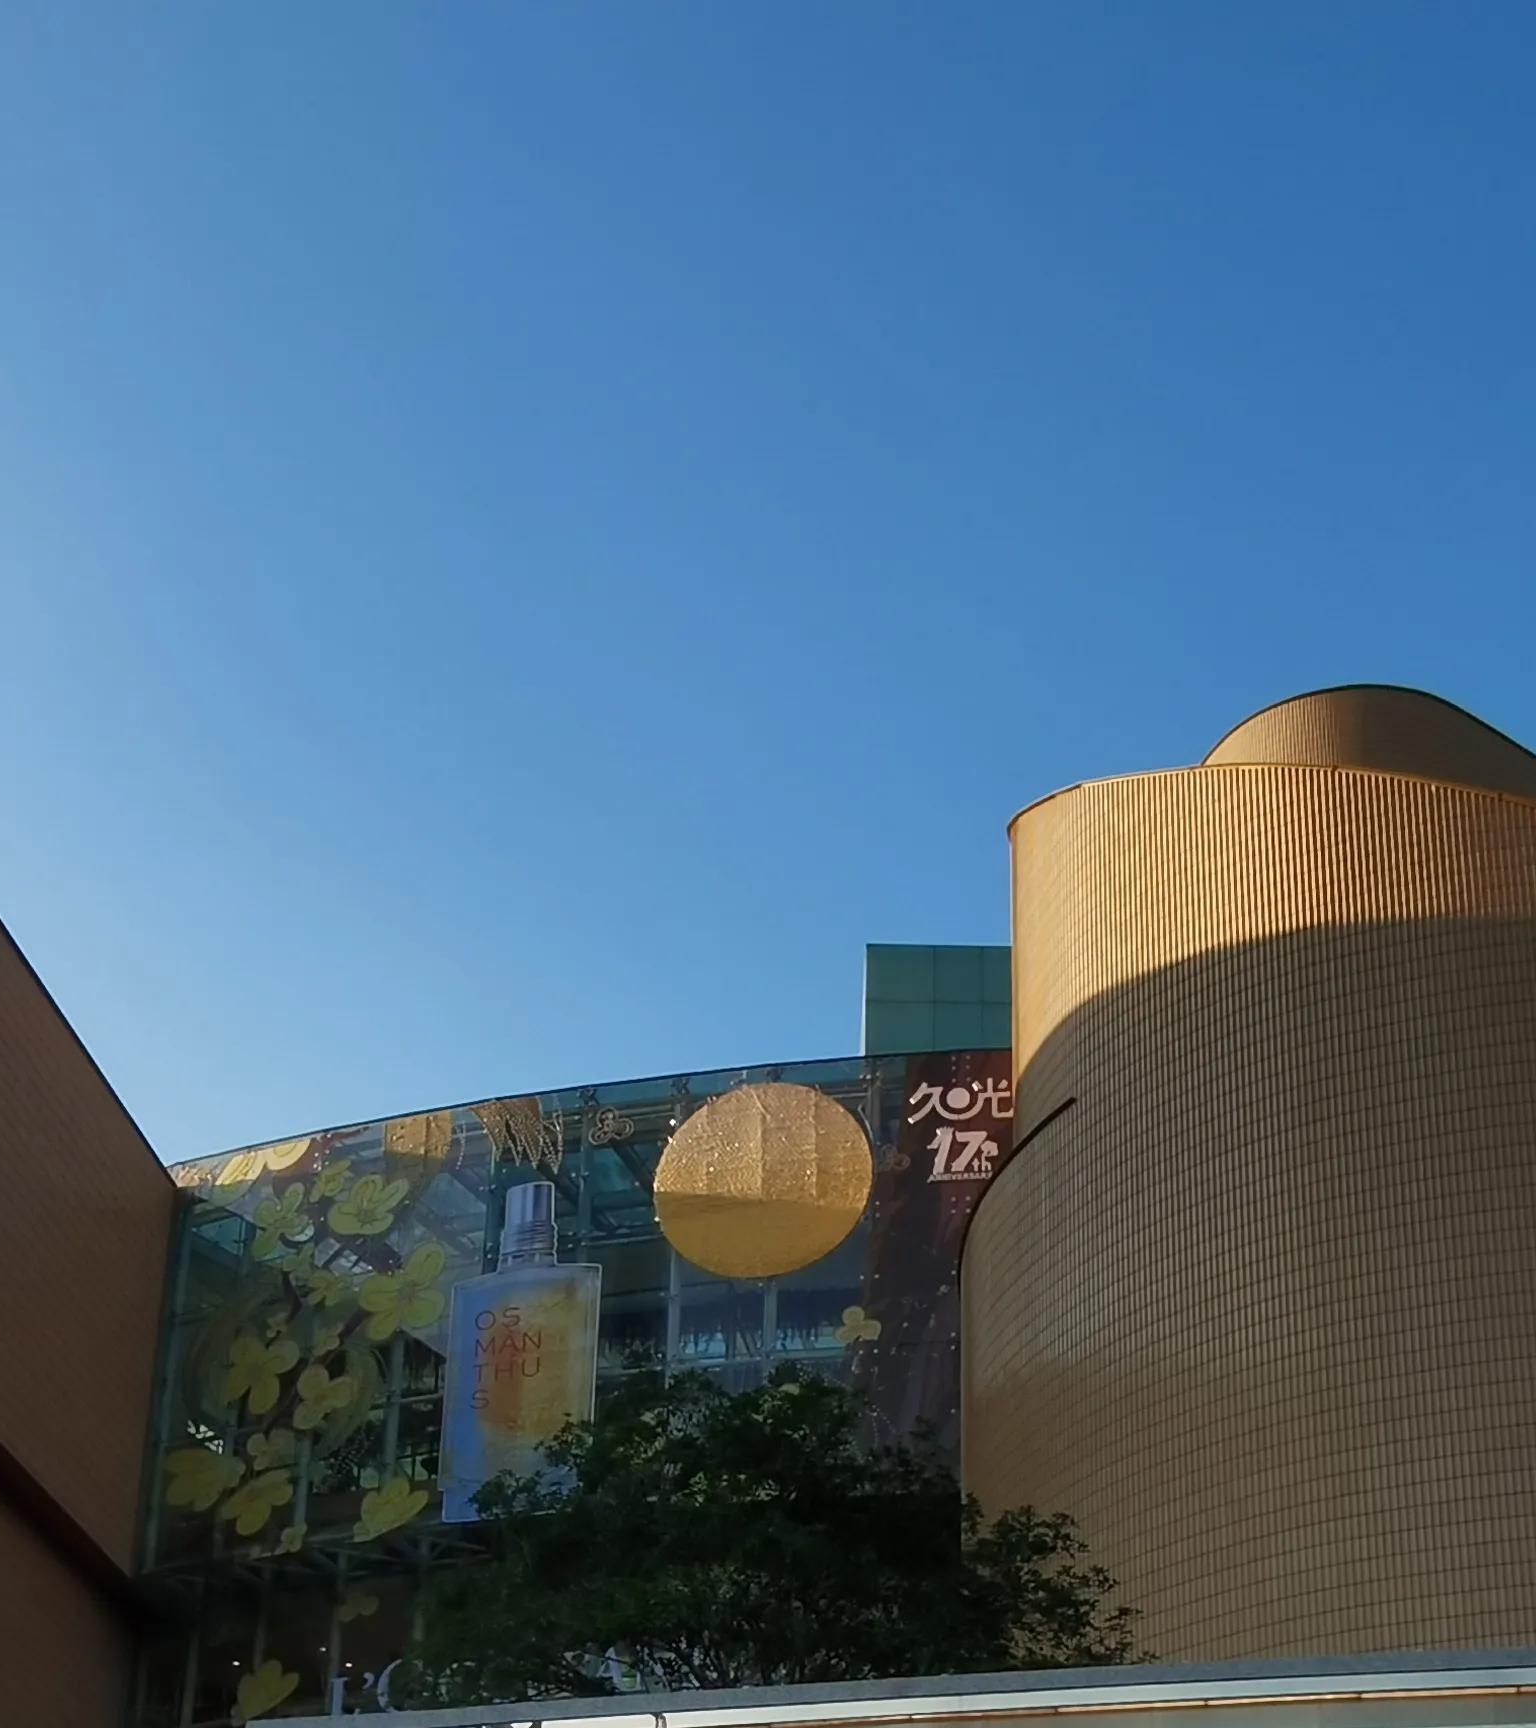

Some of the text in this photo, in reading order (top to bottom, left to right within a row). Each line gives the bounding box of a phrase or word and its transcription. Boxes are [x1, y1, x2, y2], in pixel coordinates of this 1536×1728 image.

[907, 1077, 1014, 1124] 久光
[474, 1306, 522, 1331] OS
[474, 1331, 542, 1357] MAN
[472, 1357, 541, 1383] THU
[469, 1389, 490, 1410] S
